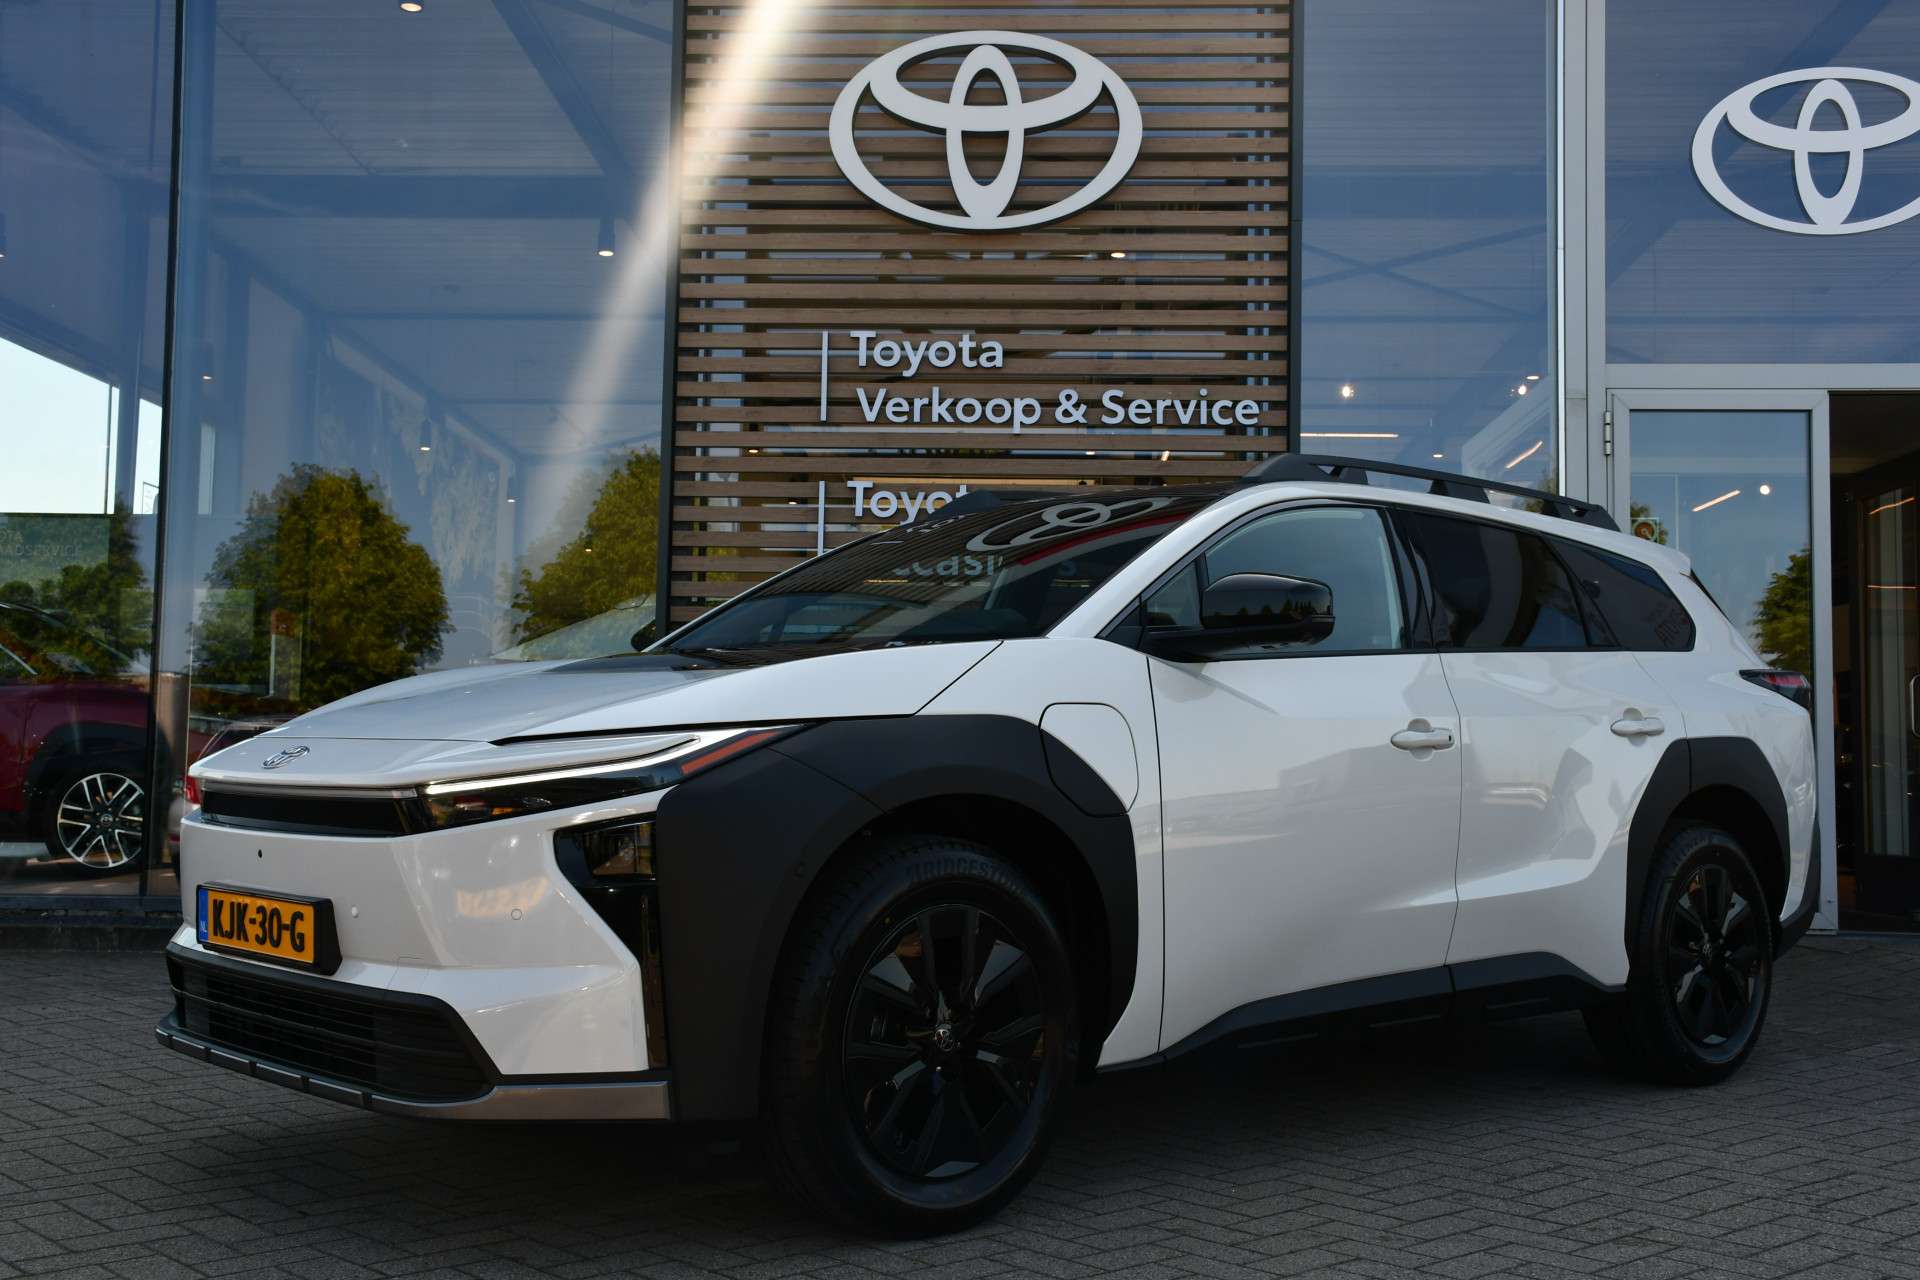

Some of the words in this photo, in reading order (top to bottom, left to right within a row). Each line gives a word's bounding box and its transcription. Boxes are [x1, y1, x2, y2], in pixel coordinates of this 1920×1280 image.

[850, 330, 1004, 378] Toyota
[856, 386, 1042, 435] Verkoop
[1054, 388, 1087, 424] &
[1101, 388, 1260, 425] Service
[213, 899, 305, 952] KJK-30-G
